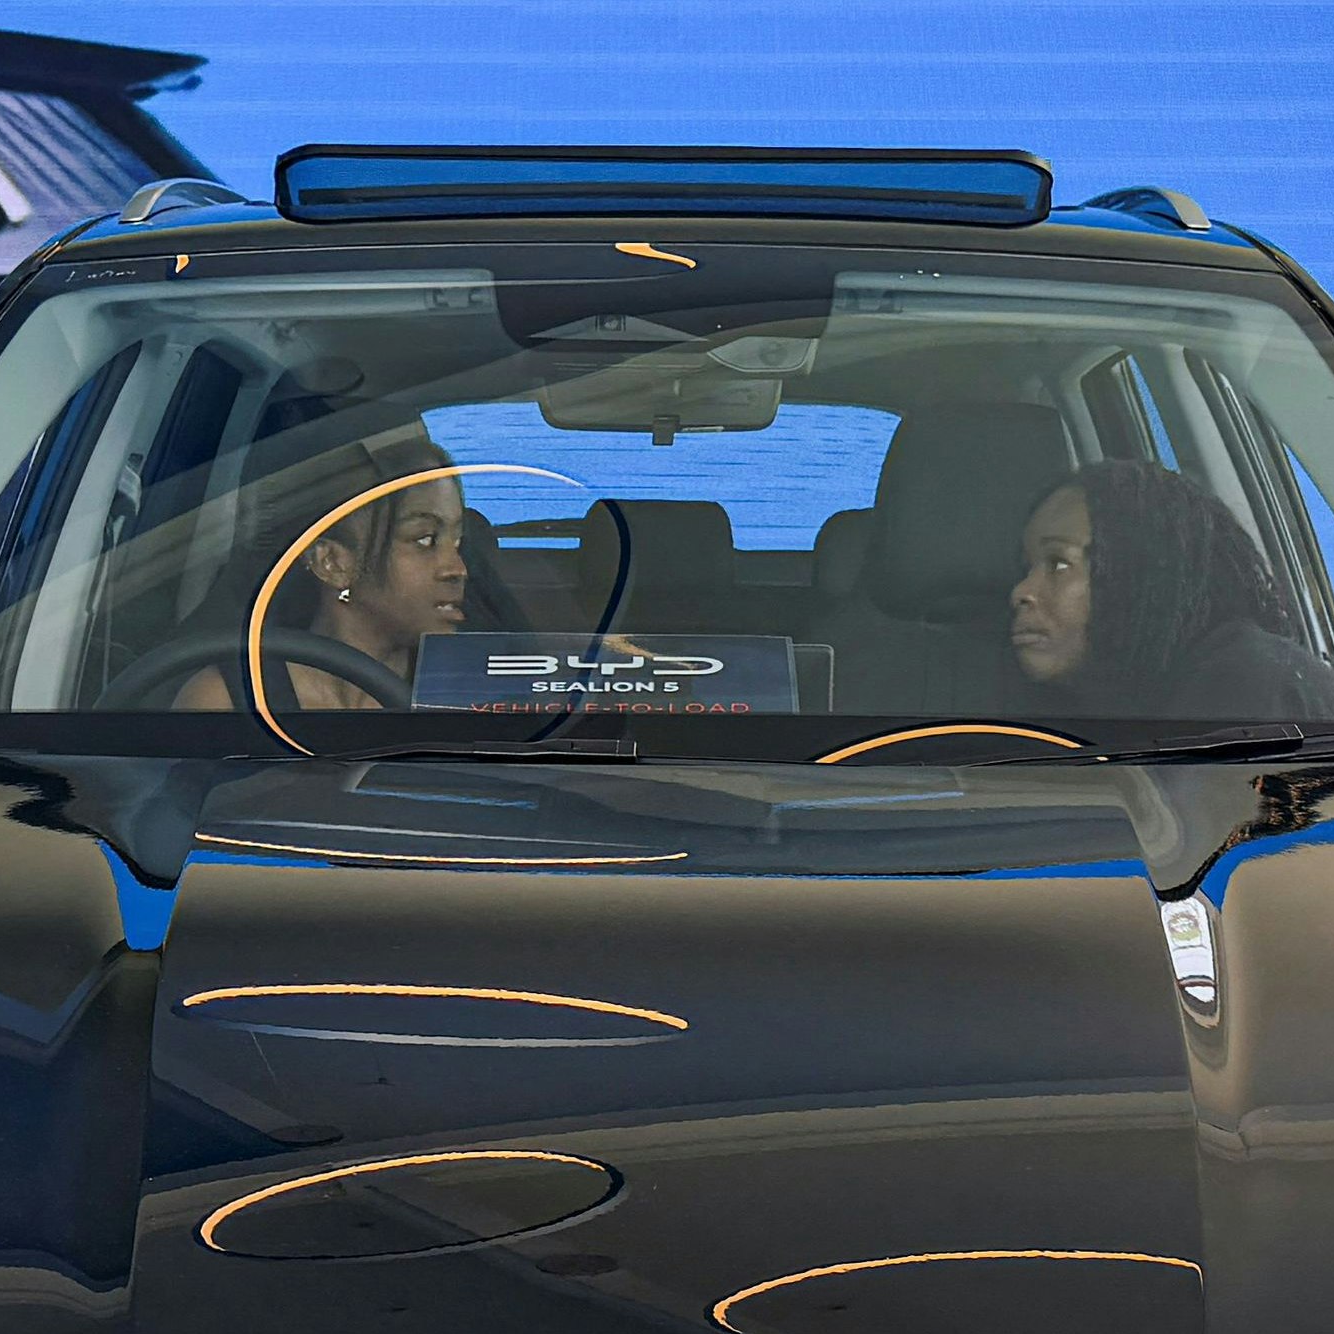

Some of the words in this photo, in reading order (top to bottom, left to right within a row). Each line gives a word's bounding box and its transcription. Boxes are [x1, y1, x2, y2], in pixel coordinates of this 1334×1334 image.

[486, 654, 725, 676] BYD
[531, 681, 655, 693] SEALION
[663, 681, 680, 693] 5
